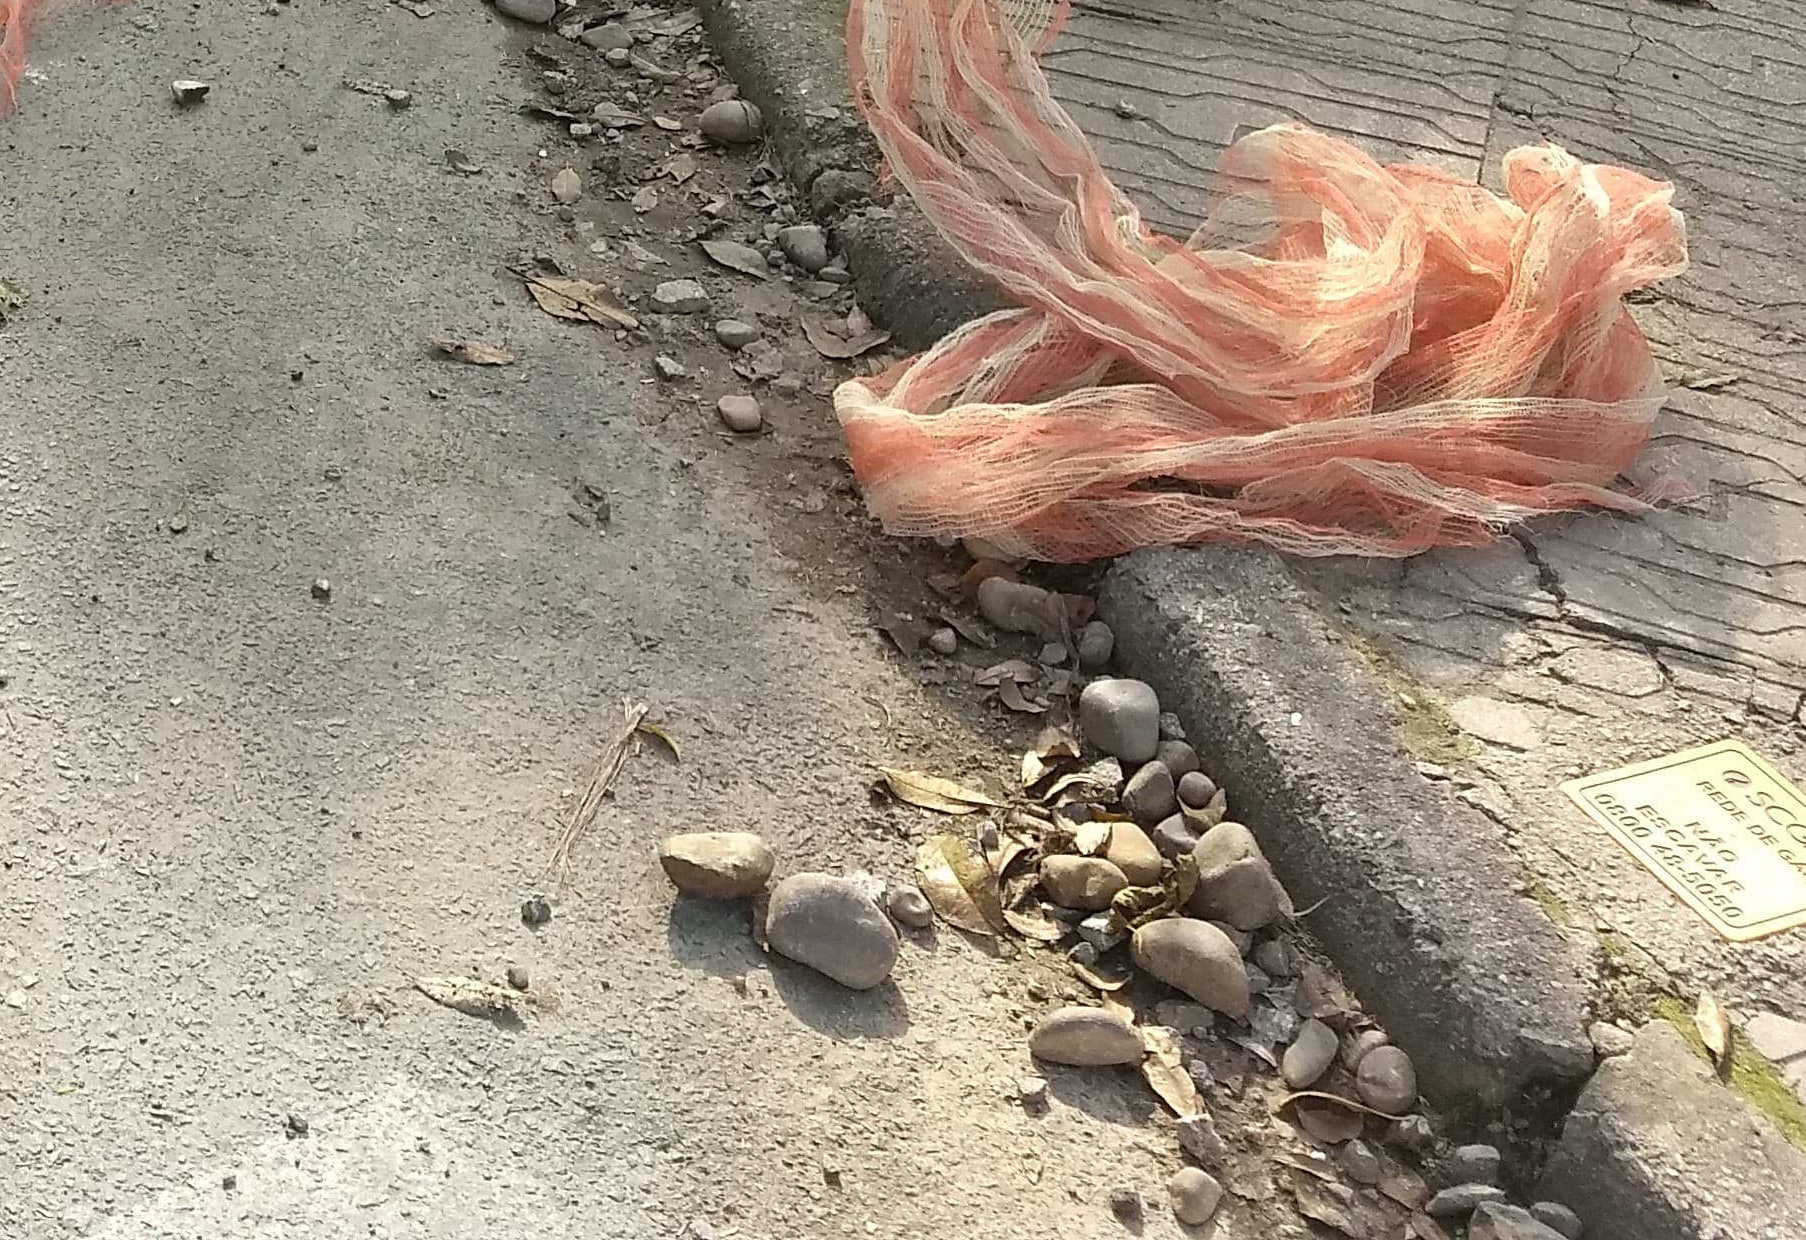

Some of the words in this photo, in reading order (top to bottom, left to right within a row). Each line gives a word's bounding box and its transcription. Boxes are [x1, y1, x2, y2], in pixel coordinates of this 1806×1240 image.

[1635, 805, 1745, 893] ESCAVAR
[1684, 821, 1738, 862] NÃO
[1695, 780, 1747, 822] REDE
[1747, 824, 1780, 846] DE
[1594, 794, 1652, 838] 0800
[1651, 844, 1743, 918] 48-5050
